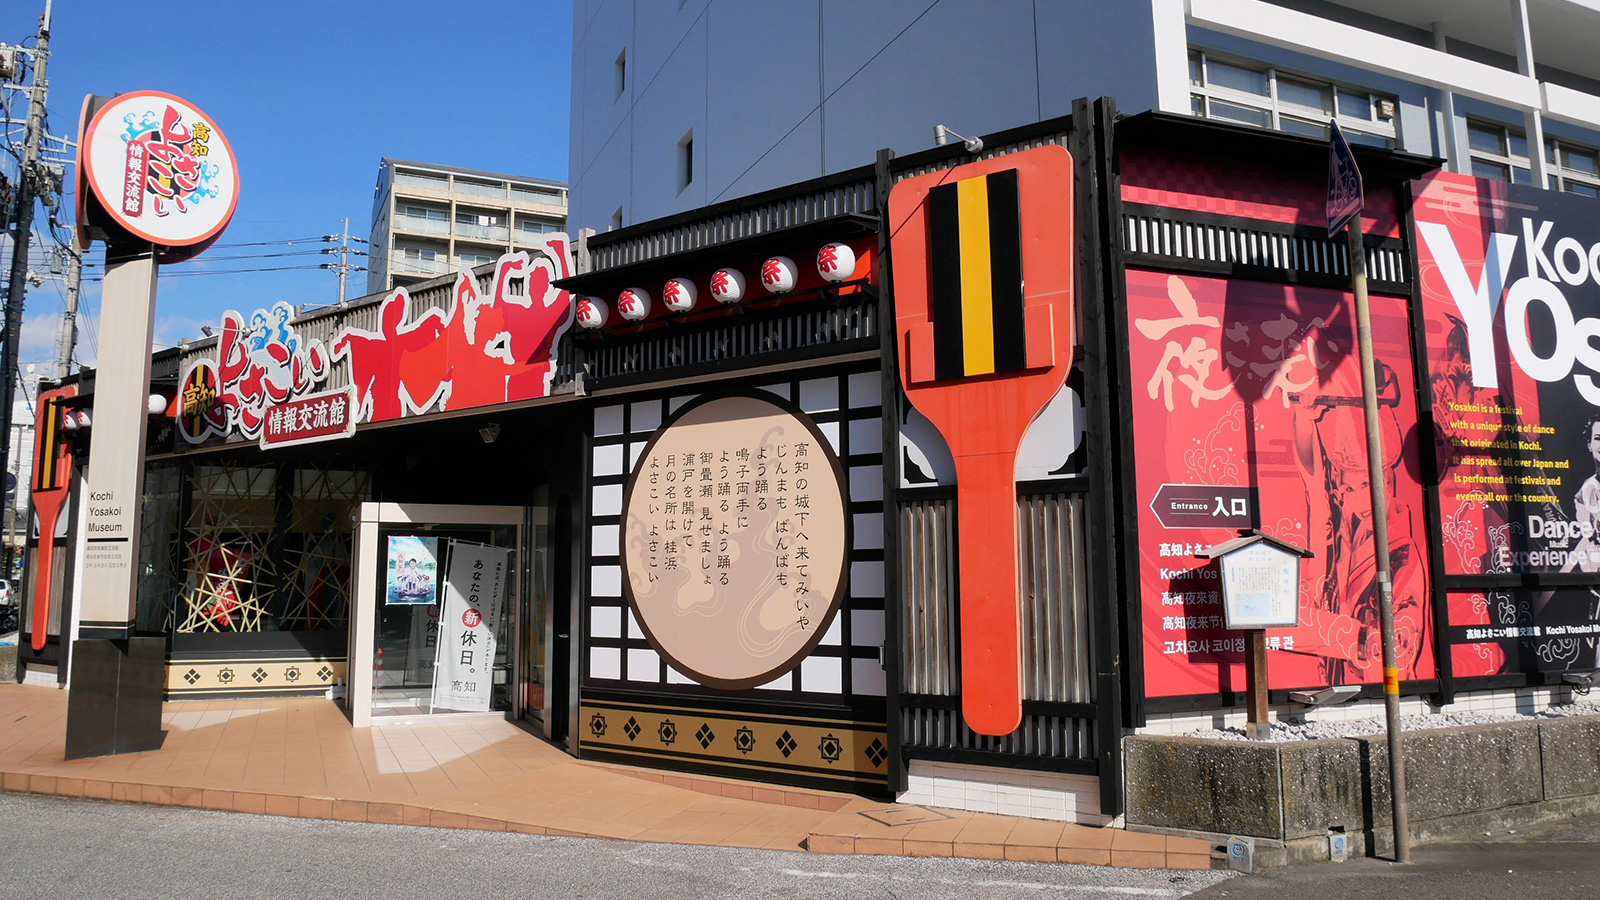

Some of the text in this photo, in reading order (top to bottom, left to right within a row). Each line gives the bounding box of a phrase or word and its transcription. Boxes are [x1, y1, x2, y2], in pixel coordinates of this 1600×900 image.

[192, 123, 211, 157] 高知
[146, 105, 200, 217] よさこい
[125, 142, 144, 213] 情報交流館
[204, 317, 322, 428] よさこい
[183, 383, 216, 417] 高知
[1449, 402, 1480, 412] Yosakoi
[1495, 405, 1523, 415] festival
[269, 397, 345, 435] 情報交流館
[1450, 420, 1468, 429] with
[1476, 422, 1502, 432] unique
[1503, 424, 1522, 433] style
[1523, 424, 1531, 432] of
[1533, 425, 1554, 434] dance
[1470, 439, 1509, 449] originated
[1510, 441, 1517, 449] in
[1519, 441, 1542, 450] Kochi.
[1453, 456, 1459, 464] It
[1476, 458, 1501, 467] spread
[1503, 458, 1513, 466] all
[1533, 459, 1553, 469] Japan
[1555, 460, 1569, 468] and
[736, 448, 750, 528] 鳴子両手に
[755, 447, 768, 510] よう踊る
[1454, 474, 1461, 482] is
[1463, 474, 1503, 484] performed
[1514, 476, 1545, 485] festivals
[1547, 477, 1560, 485] and
[91, 491, 113, 501] Kochi
[682, 453, 695, 547] 浦戸を開けて
[1212, 497, 1246, 516] 入口
[1456, 493, 1483, 501] events
[1484, 492, 1494, 501] all
[1514, 493, 1526, 502] the
[1528, 494, 1559, 504] country.
[90, 507, 121, 516] Yosakoi
[648, 457, 659, 583] よさこい よさこい
[664, 454, 677, 570] 月の名所は 桂浜
[700, 452, 713, 585] 御畳瀬 見せましょ
[718, 450, 731, 585] よう踊る よう踊る
[775, 444, 788, 586] じんまも ばんばも
[88, 522, 122, 532] Museum
[794, 442, 809, 630] 高知の城下へ来てみいや
[1528, 516, 1592, 538] Dance
[1499, 546, 1587, 567] Experience
[1160, 568, 1193, 580] Kochi
[1161, 591, 1221, 606] 高知夜來資
[1546, 626, 1565, 635] Kochi
[1566, 625, 1592, 633] Yosakoi
[452, 680, 476, 692] 高知
